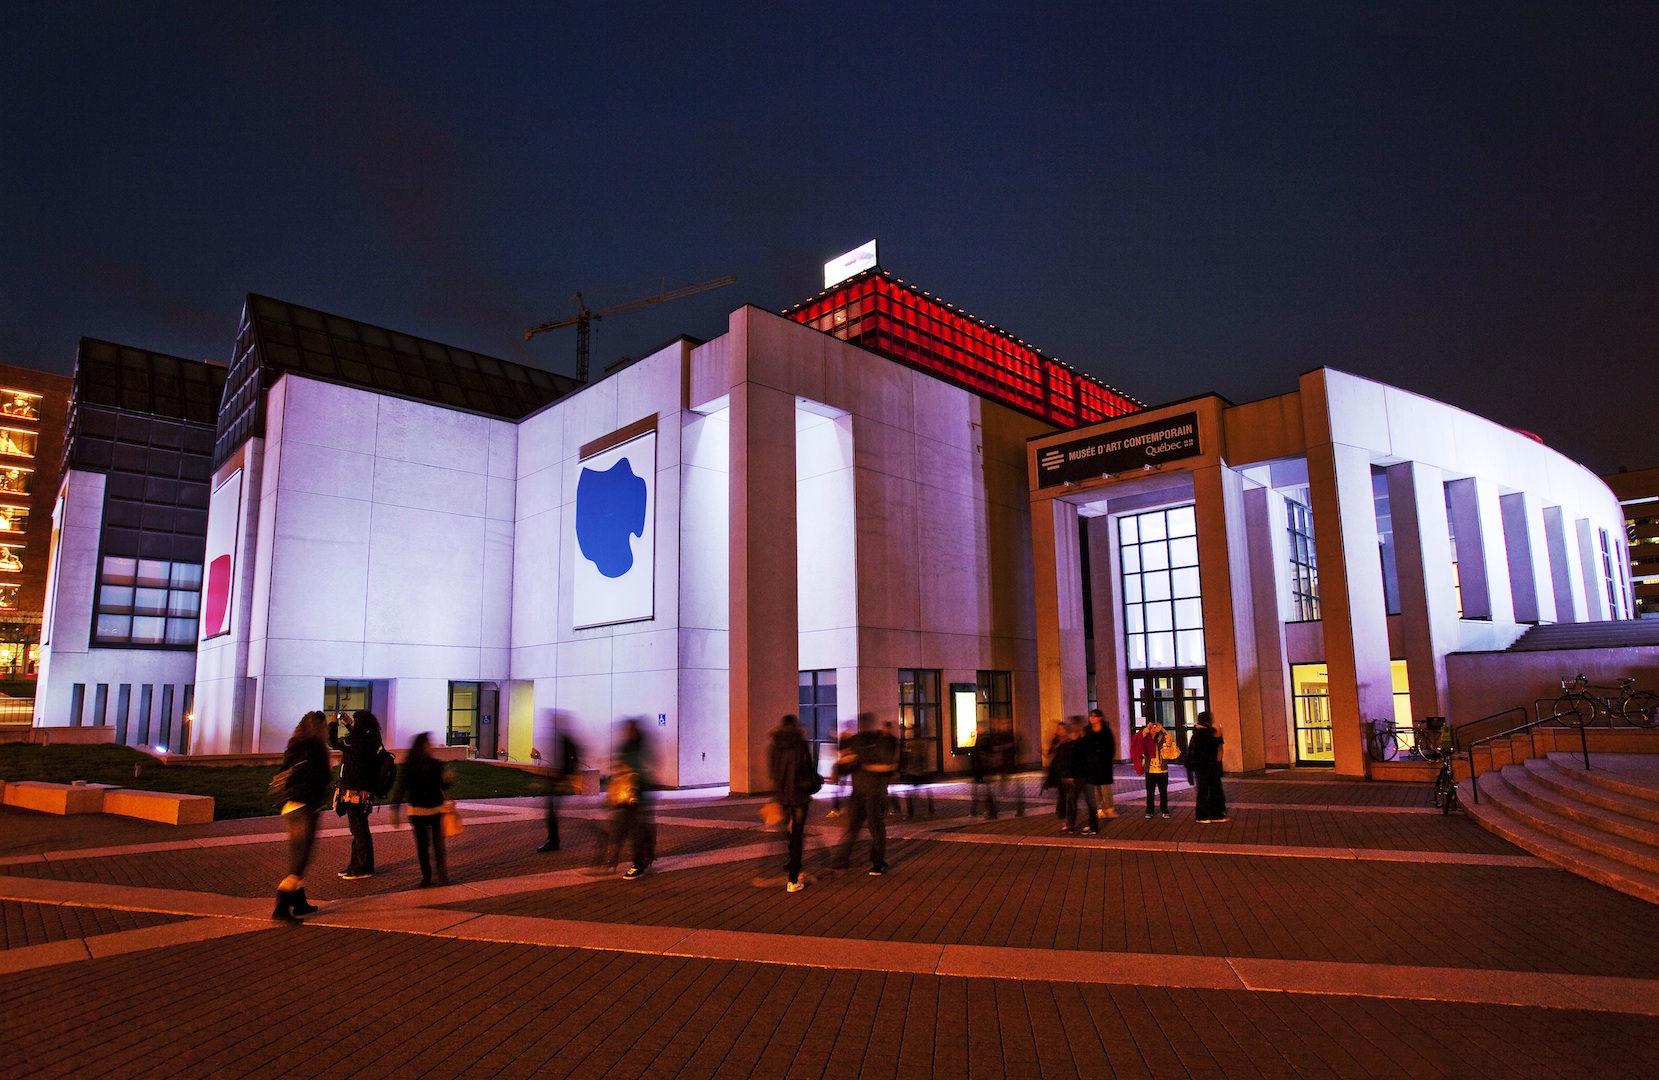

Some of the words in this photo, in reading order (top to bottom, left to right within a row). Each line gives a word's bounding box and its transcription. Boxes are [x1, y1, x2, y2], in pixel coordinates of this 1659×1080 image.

[1069, 446, 1096, 461] MUSÉE
[1097, 440, 1122, 455] D'ART
[1123, 424, 1193, 449] CONTEMPORAIN
[1145, 441, 1182, 457] Québec
